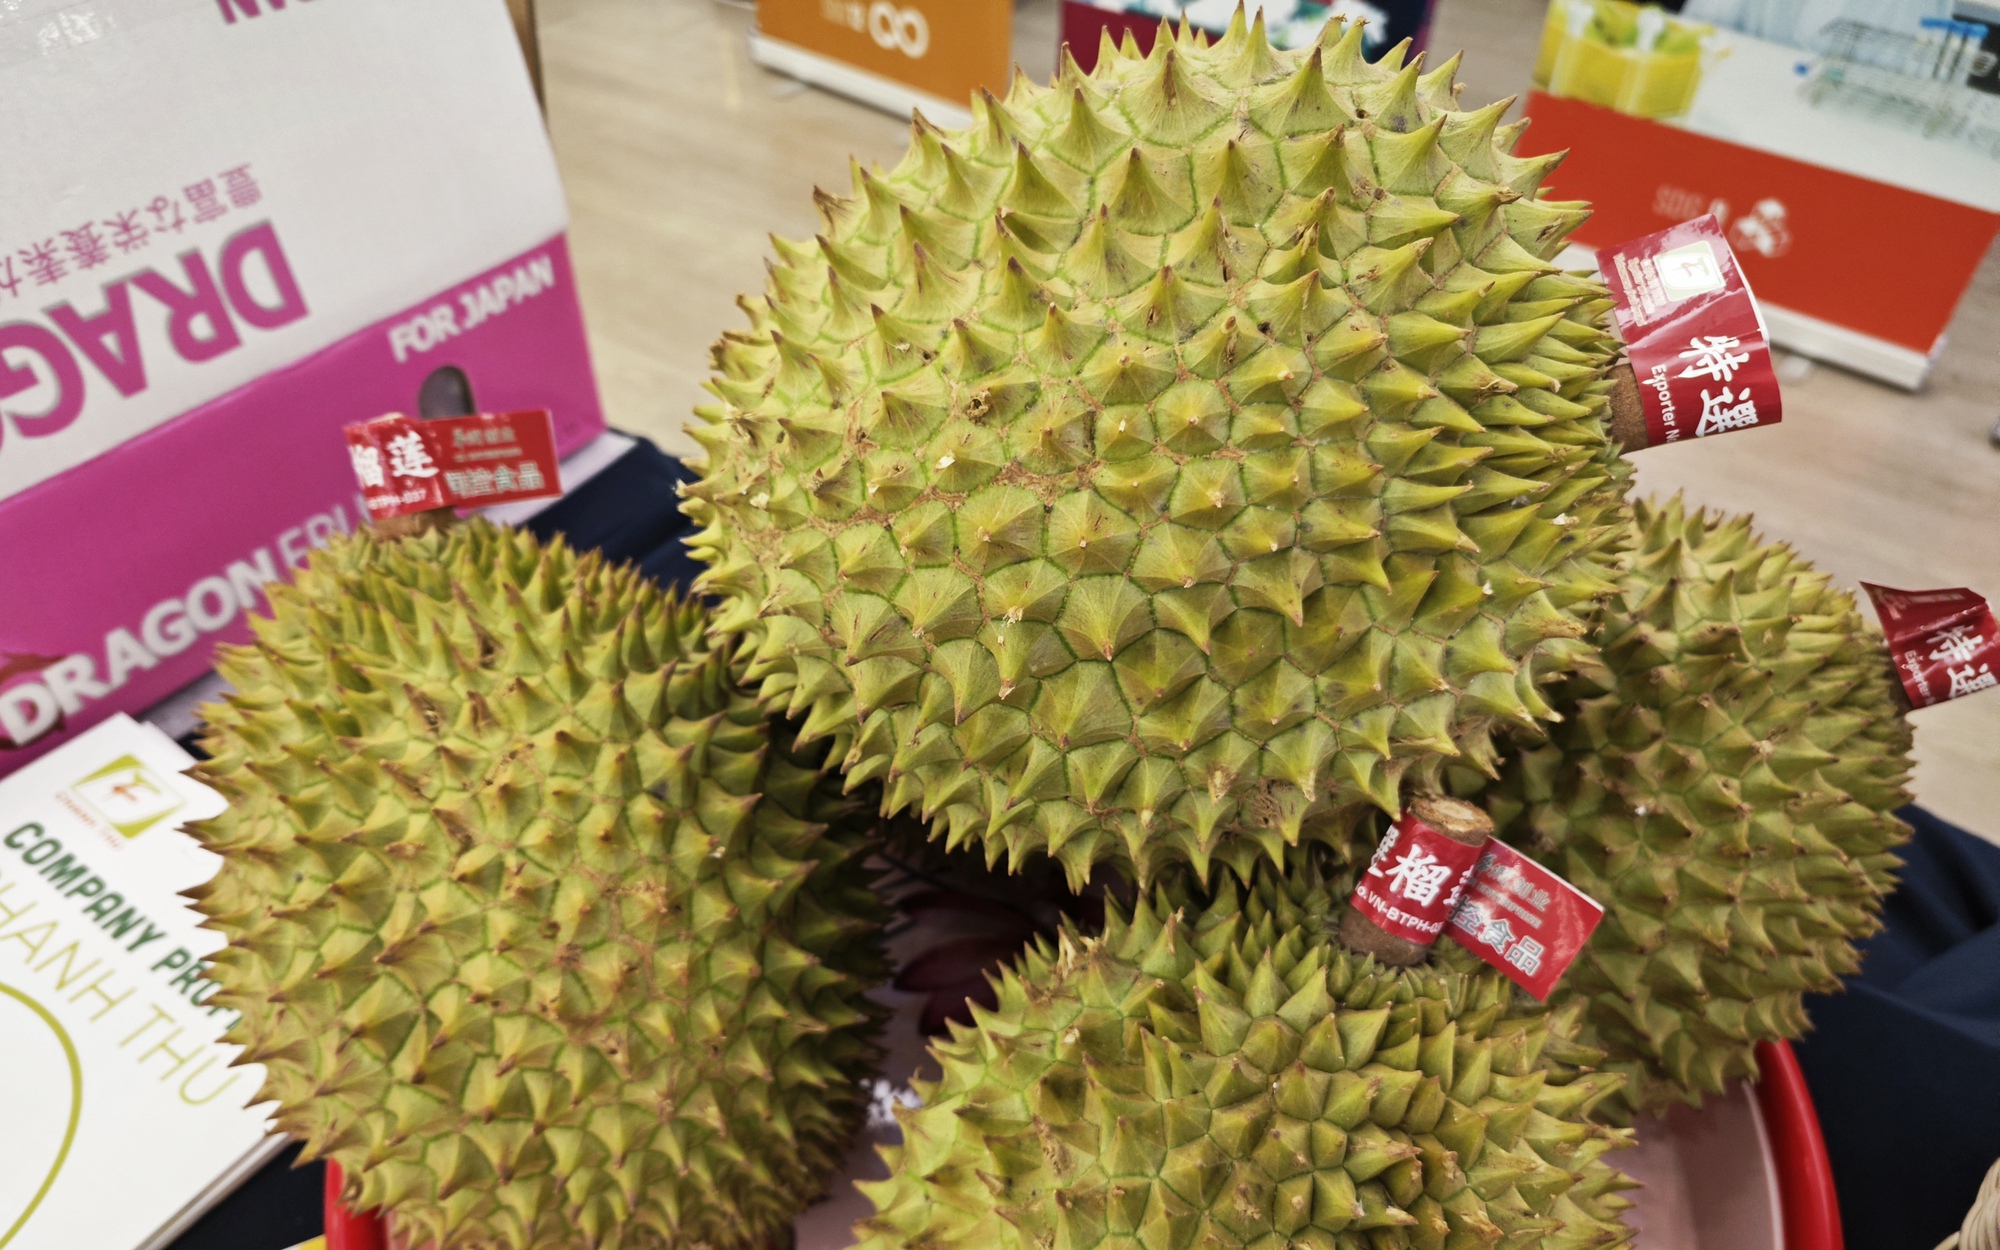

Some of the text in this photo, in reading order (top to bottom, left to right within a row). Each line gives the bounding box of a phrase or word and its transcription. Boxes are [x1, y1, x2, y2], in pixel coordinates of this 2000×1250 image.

[0, 218, 310, 450] DRAG
[389, 254, 555, 363] FOR JAPAN
[1651, 364, 1676, 427] Exporter
[1678, 335, 1758, 437] 特選
[0, 547, 279, 747] DRAGON
[3, 822, 167, 952] COMPANY
[0, 868, 243, 1106] HANH THU
